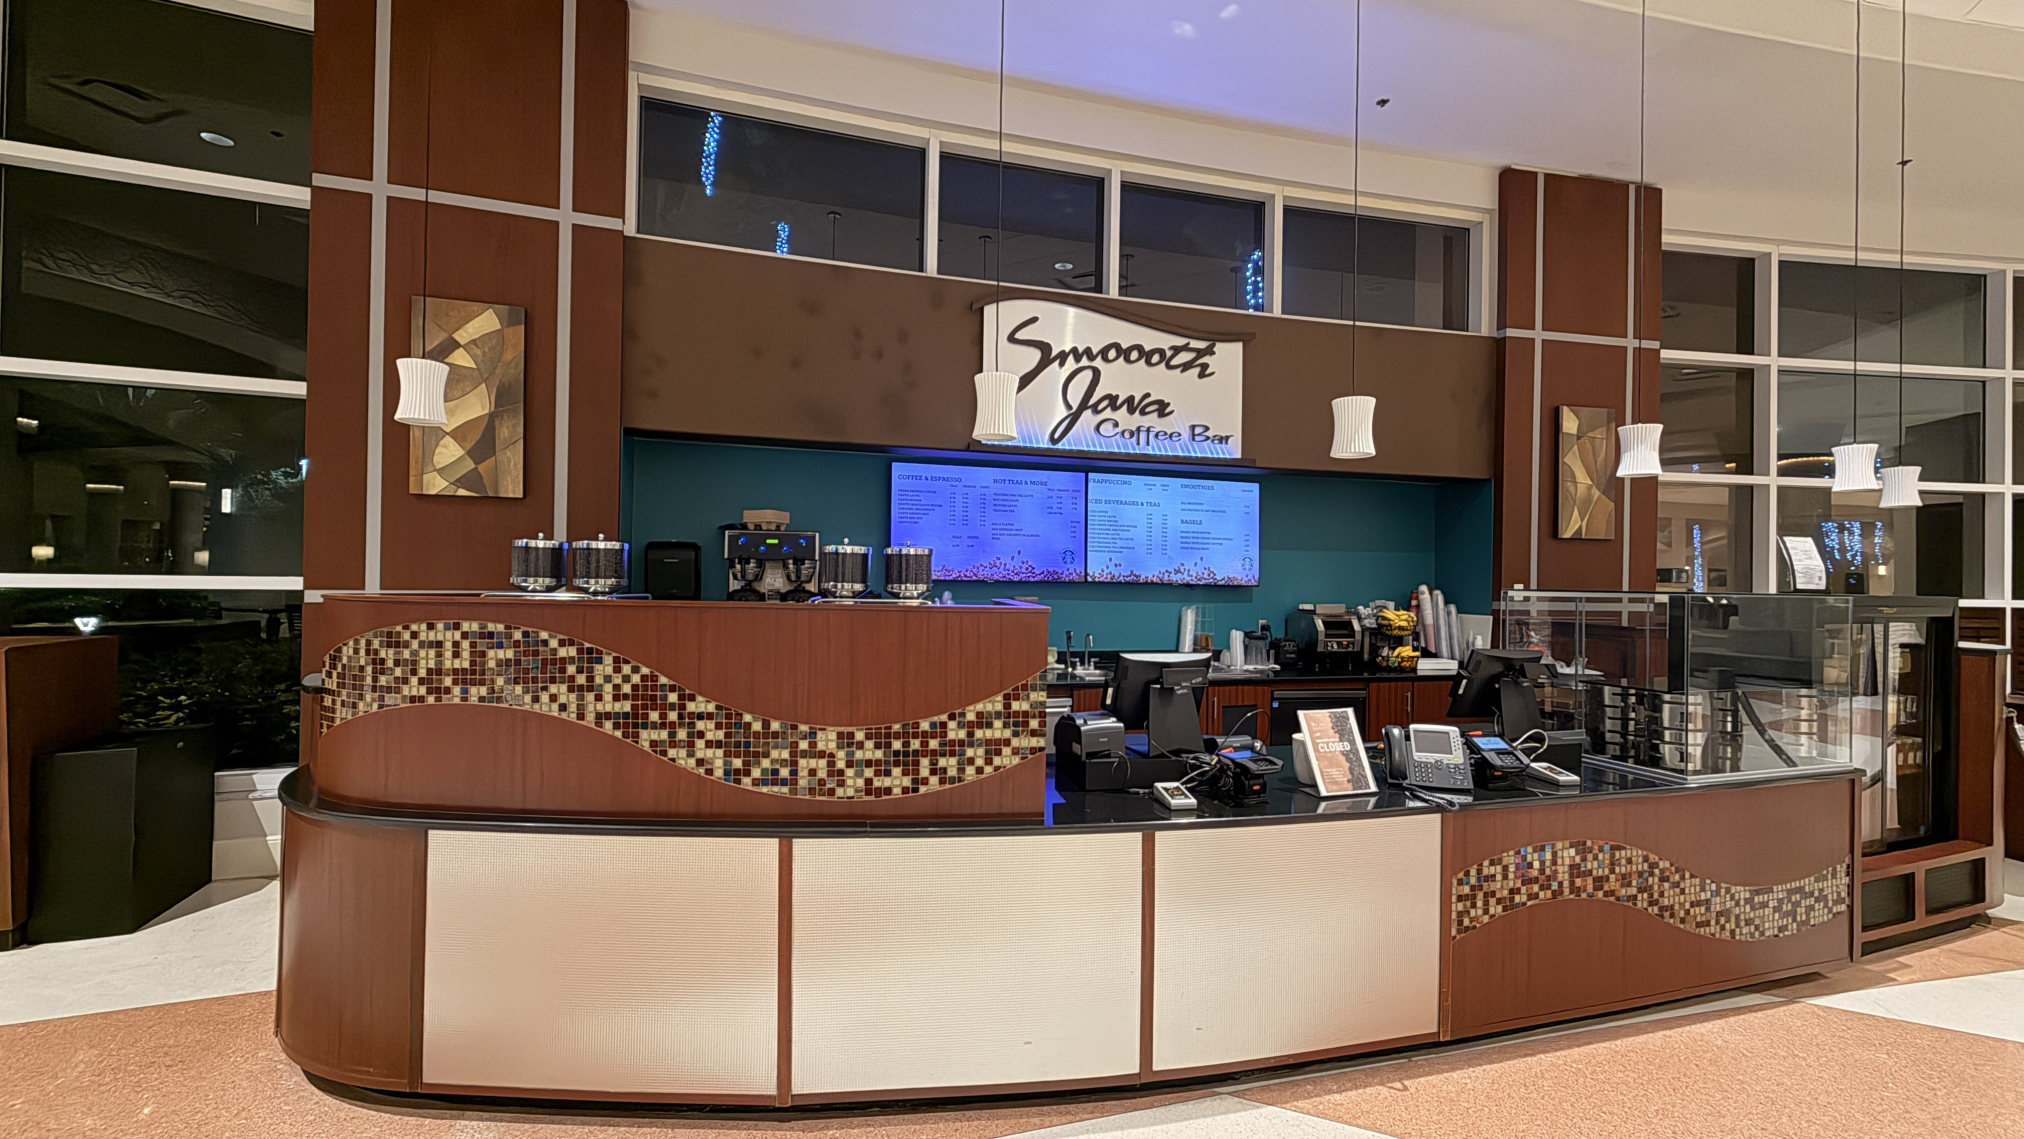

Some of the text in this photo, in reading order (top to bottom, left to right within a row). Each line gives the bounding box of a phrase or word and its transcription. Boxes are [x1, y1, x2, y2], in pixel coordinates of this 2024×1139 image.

[1006, 315, 1217, 396] Smoooth
[1049, 364, 1175, 446] Java
[1094, 417, 1235, 447] Coffee Bar
[930, 475, 962, 483] ESPRESSO
[1088, 478, 1132, 486] FRAPPUCCINO
[1180, 483, 1215, 491] SMOOTHIES
[1318, 741, 1351, 753] CLOSED
